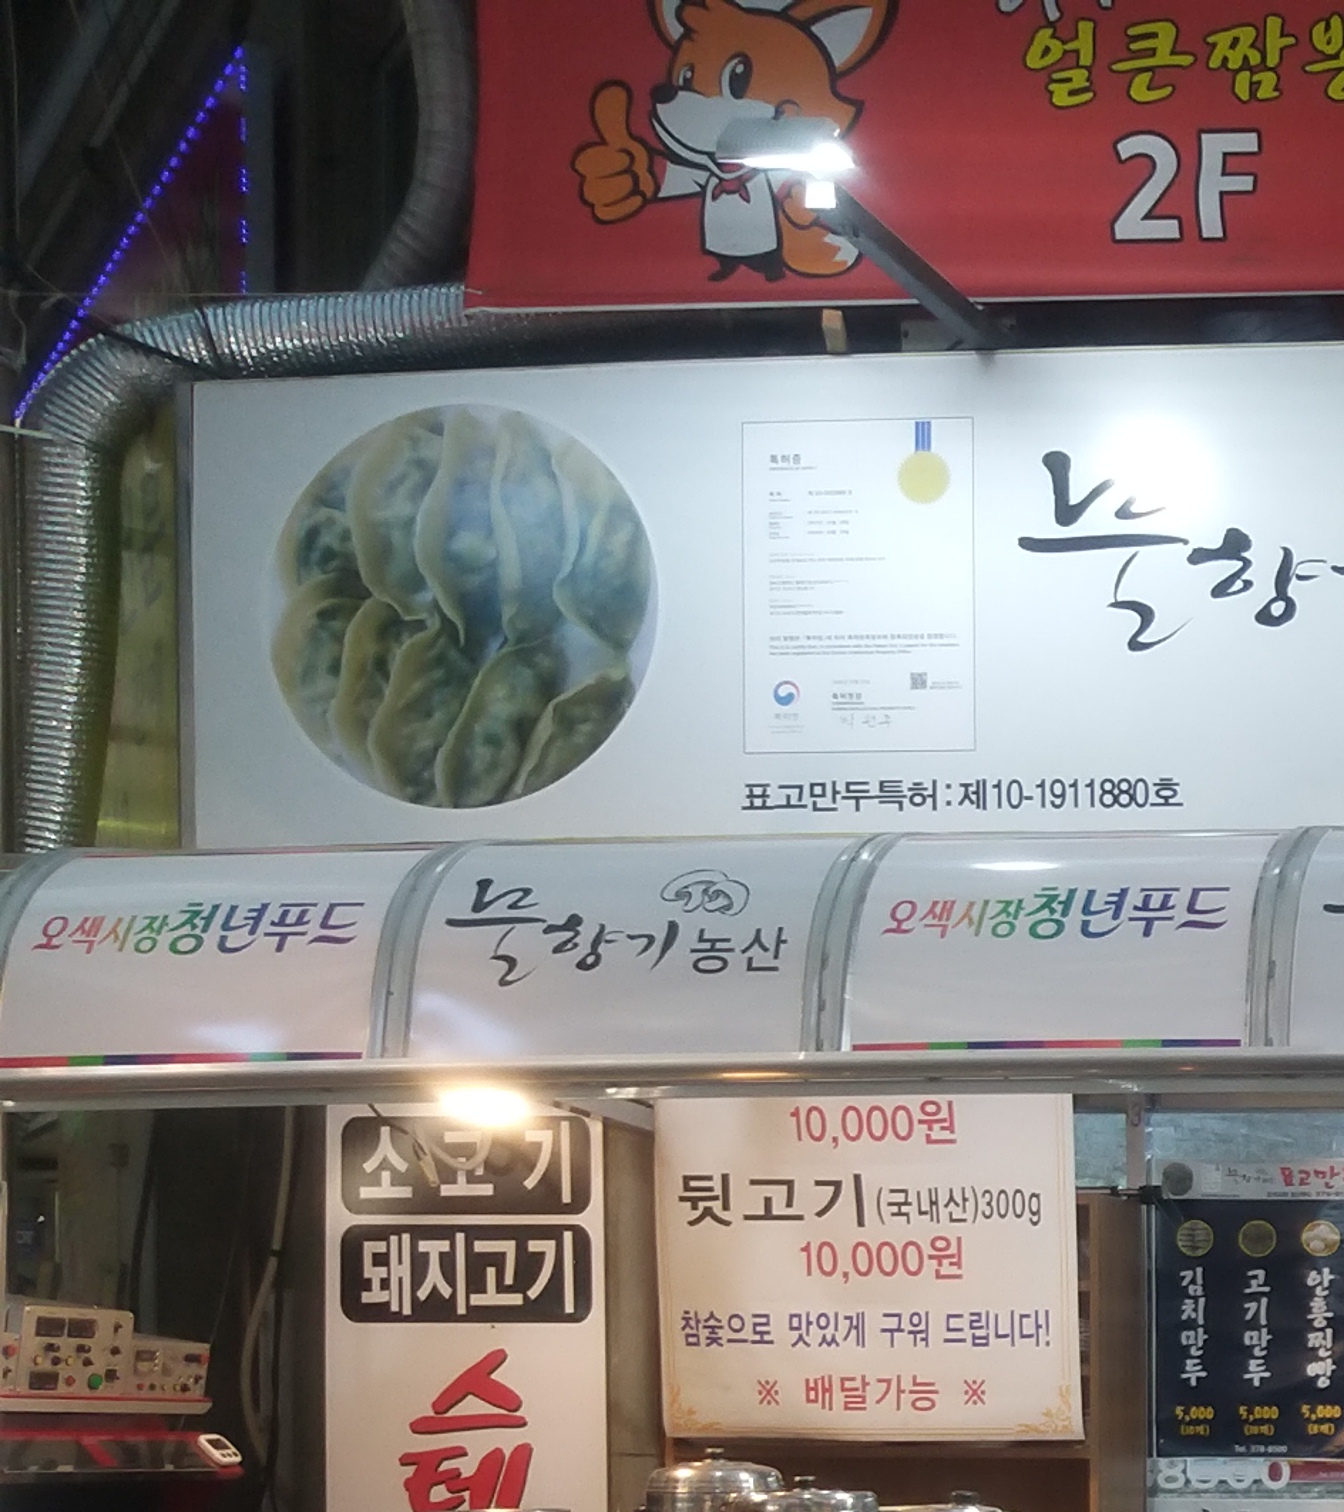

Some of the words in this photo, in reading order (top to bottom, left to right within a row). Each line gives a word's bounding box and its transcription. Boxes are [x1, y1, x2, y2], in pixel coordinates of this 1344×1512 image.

[1111, 130, 1261, 243] 2F
[789, 1100, 957, 1149] 10,000원
[361, 1231, 575, 1316] 돼지고기
[800, 1235, 963, 1284] 10,000원
[680, 1310, 775, 1348] 참숯으로
[787, 1309, 866, 1348] 맛있게
[880, 1310, 931, 1348] 구워
[942, 1309, 1051, 1348] 드립니다!
[1180, 1267, 1208, 1387] 김치만두
[1243, 1268, 1272, 1387] 고기만두
[1306, 1267, 1337, 1389] 안흥찐빵
[804, 1374, 940, 1411] 배달가능
